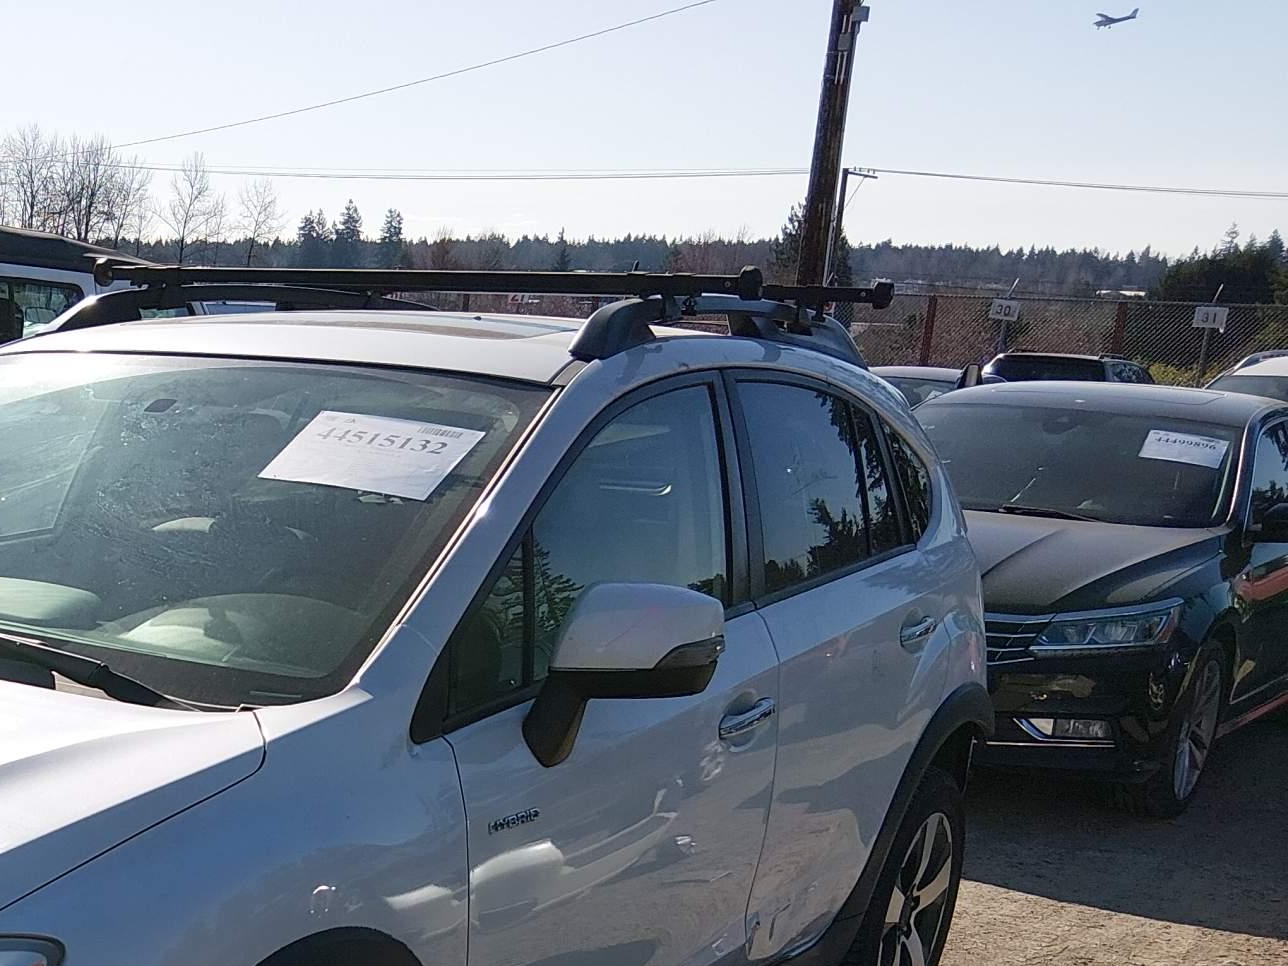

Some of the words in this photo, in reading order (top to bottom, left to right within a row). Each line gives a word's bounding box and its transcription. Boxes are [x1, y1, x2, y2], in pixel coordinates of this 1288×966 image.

[996, 304, 1011, 316] 30
[1202, 311, 1217, 323] 31
[317, 427, 448, 455] 44515132
